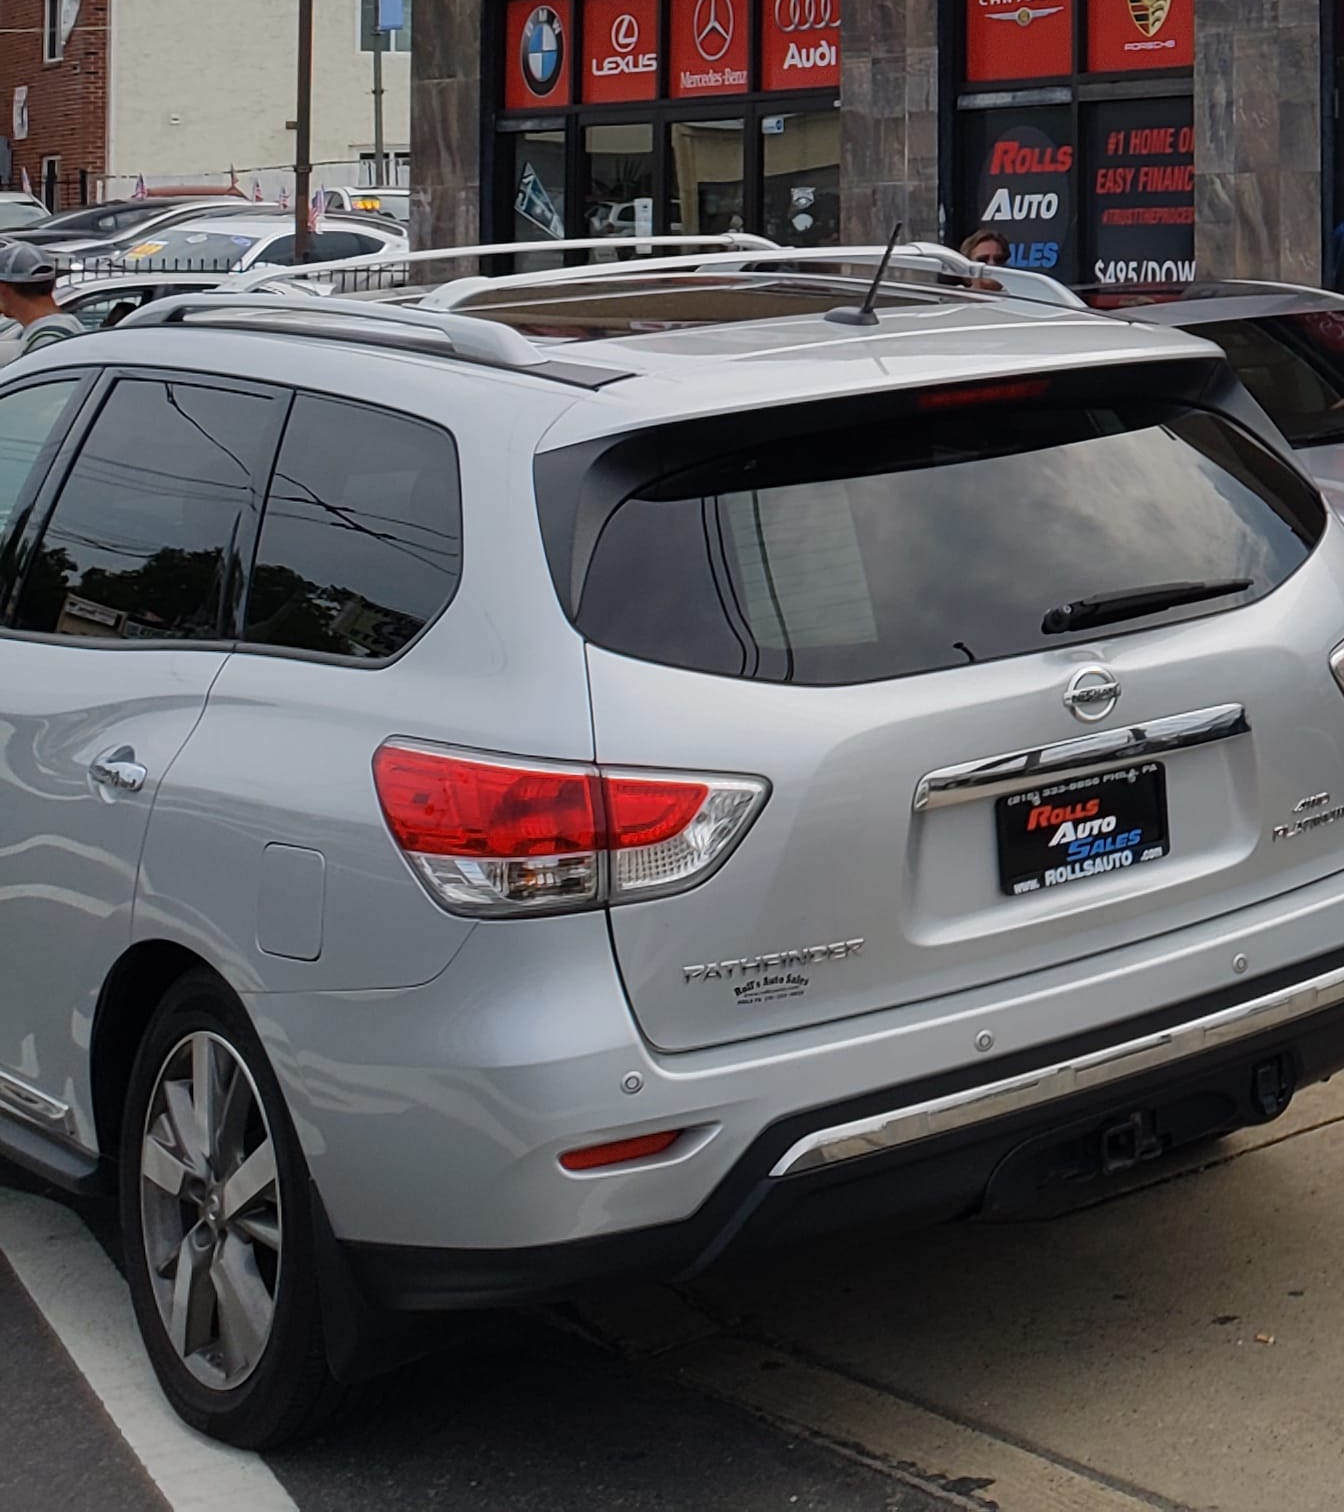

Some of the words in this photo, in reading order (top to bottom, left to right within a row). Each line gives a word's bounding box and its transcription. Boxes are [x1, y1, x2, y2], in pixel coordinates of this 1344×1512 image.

[592, 53, 657, 75] LEXUS
[784, 41, 837, 69] Audi
[681, 68, 747, 88] Mercedes-Benz
[1107, 131, 1125, 156] #1
[1129, 127, 1175, 155] HOME
[990, 141, 1073, 175] ROLLS
[1095, 168, 1135, 194] EASY
[1138, 165, 1194, 193] FINANC
[981, 188, 1059, 221] AUTO
[1008, 242, 1060, 269] ALES
[1095, 259, 1196, 283] $495/DOW
[1027, 798, 1100, 831] ROLLS
[1048, 816, 1117, 847] AUTO
[1067, 829, 1142, 862] SALES
[1045, 850, 1133, 887] ROLLSAUTO
[683, 938, 865, 984] PATHFINDER
